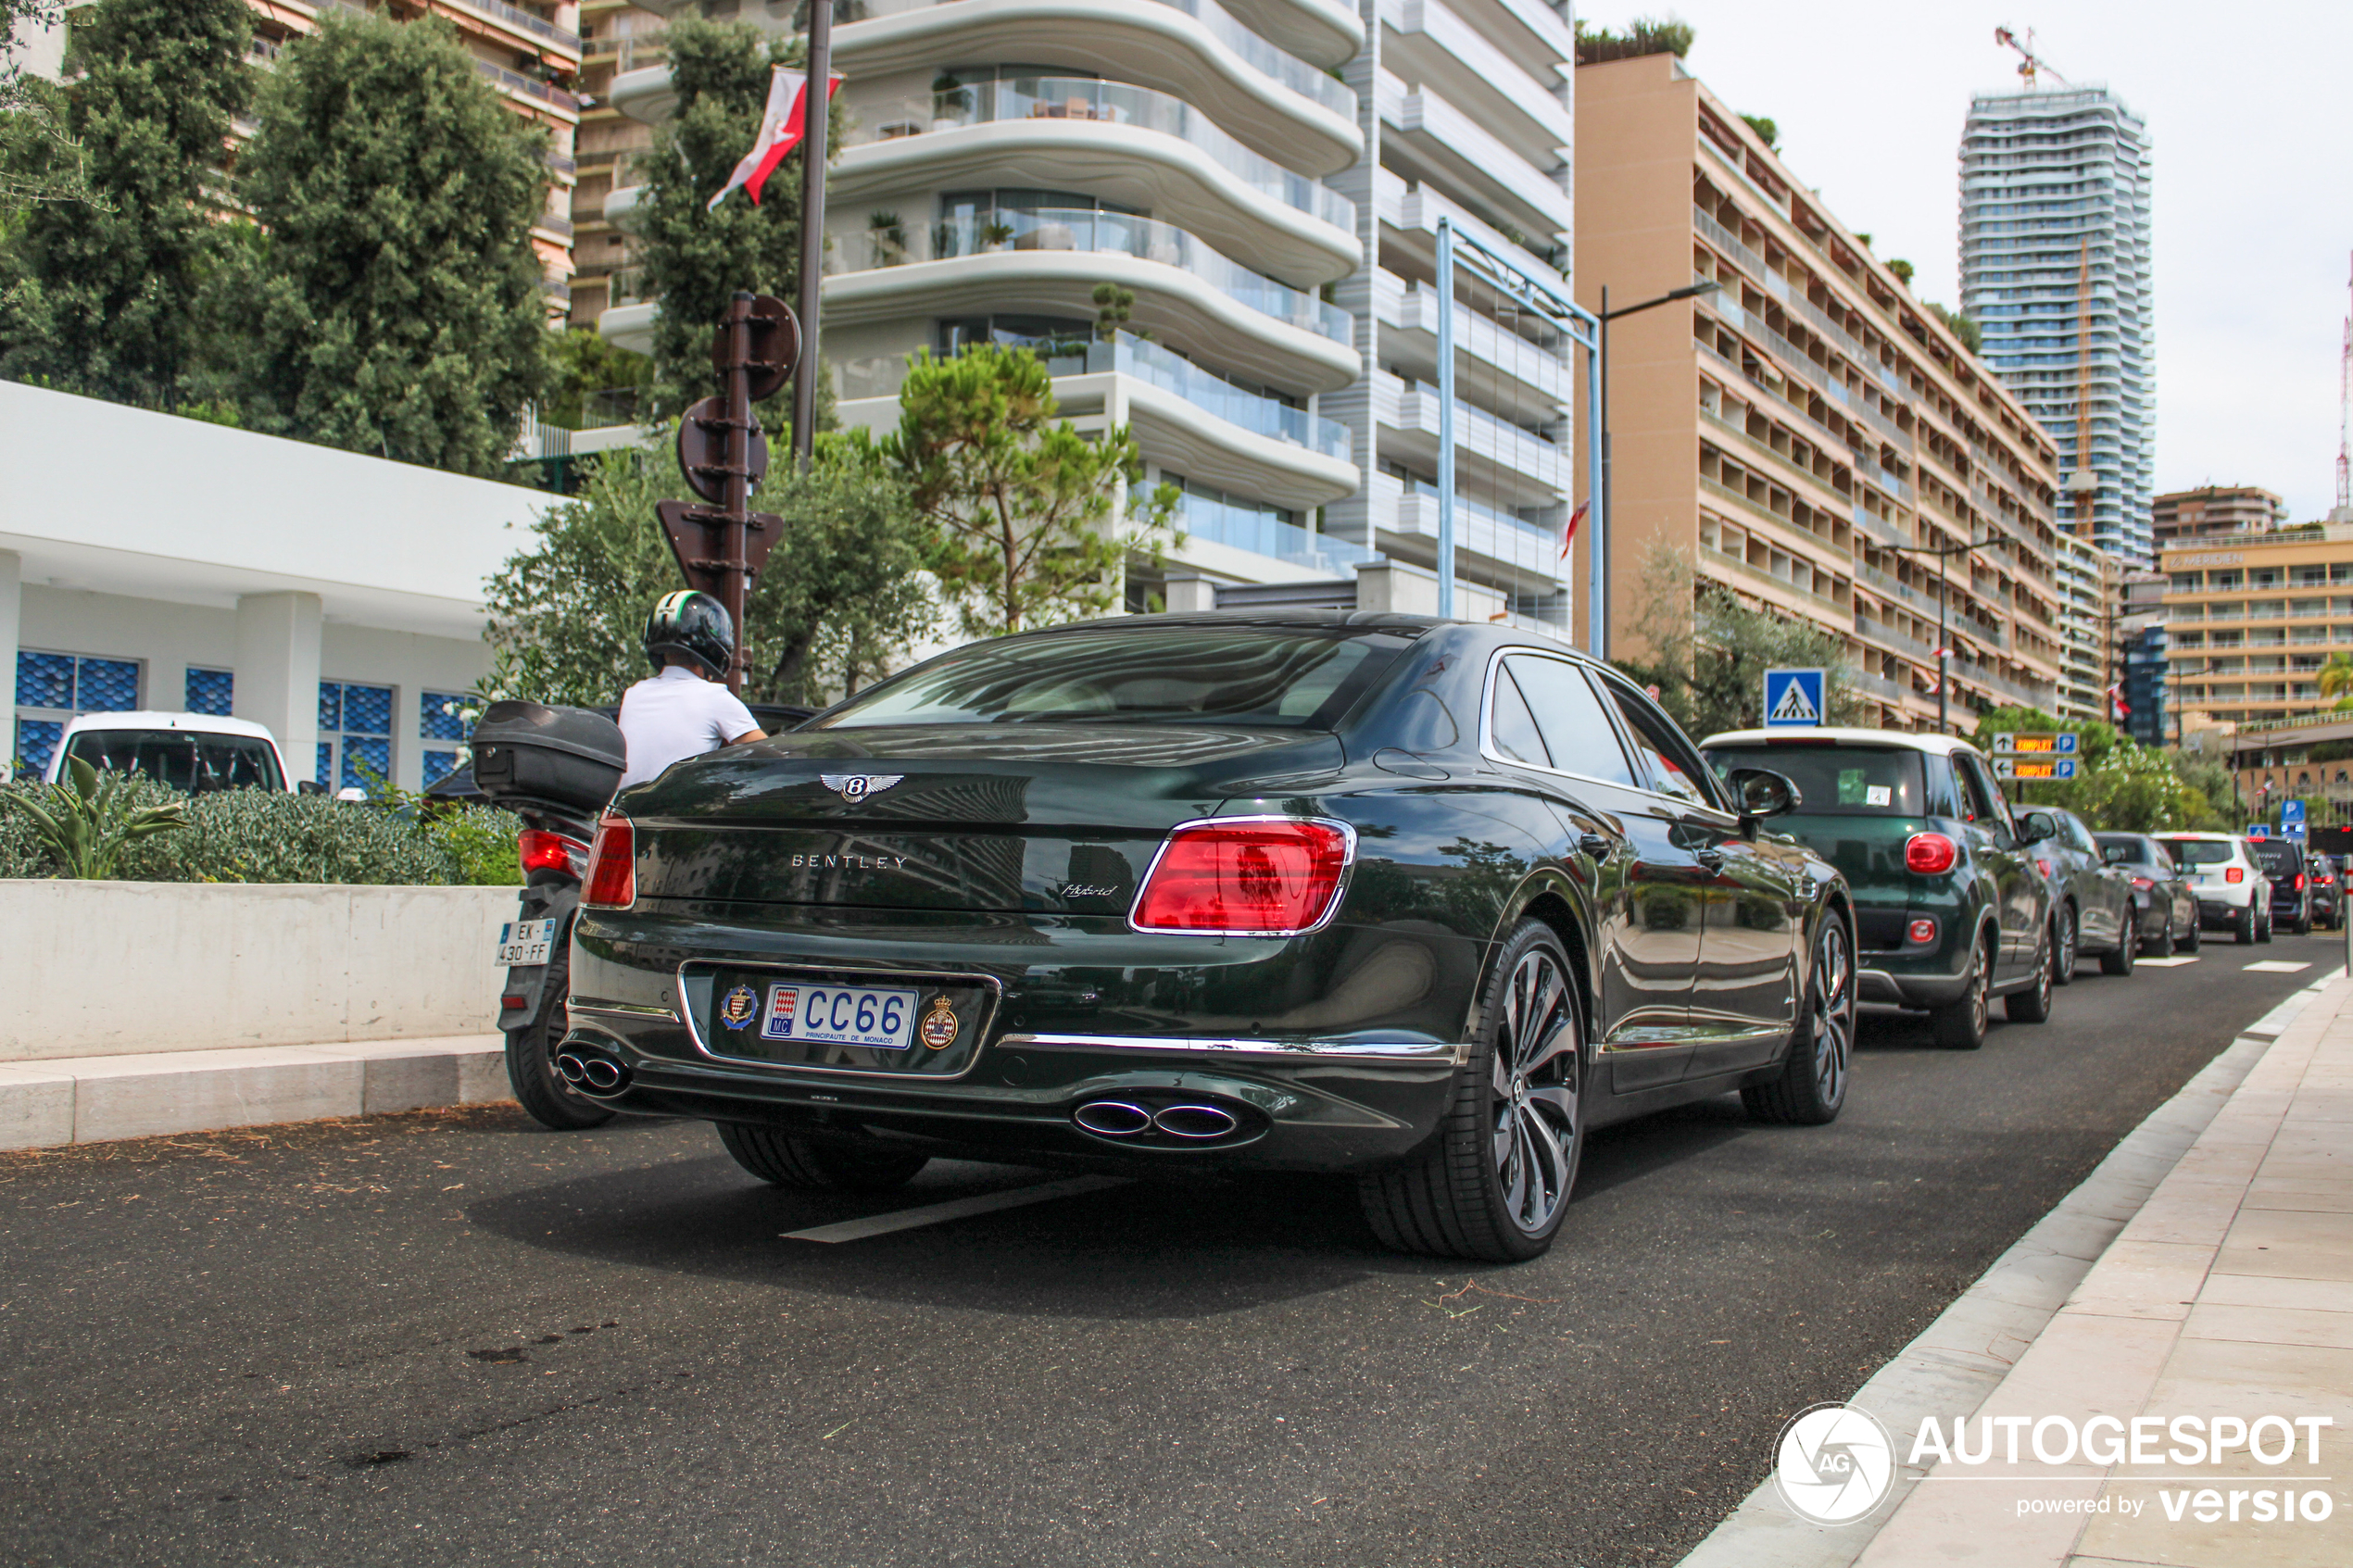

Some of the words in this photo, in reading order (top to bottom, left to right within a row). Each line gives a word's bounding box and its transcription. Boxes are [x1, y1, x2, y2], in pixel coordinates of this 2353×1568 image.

[2016, 739, 2053, 752] COMPLET
[2016, 765, 2053, 777] COMPLET
[791, 854, 907, 869] BENTLEY
[1061, 884, 1118, 898] Hybrid
[806, 991, 904, 1034] CC66
[773, 1020, 788, 1032] MC
[805, 1032, 846, 1041] PRINCIPAUTE
[863, 1035, 894, 1045] MONACO
